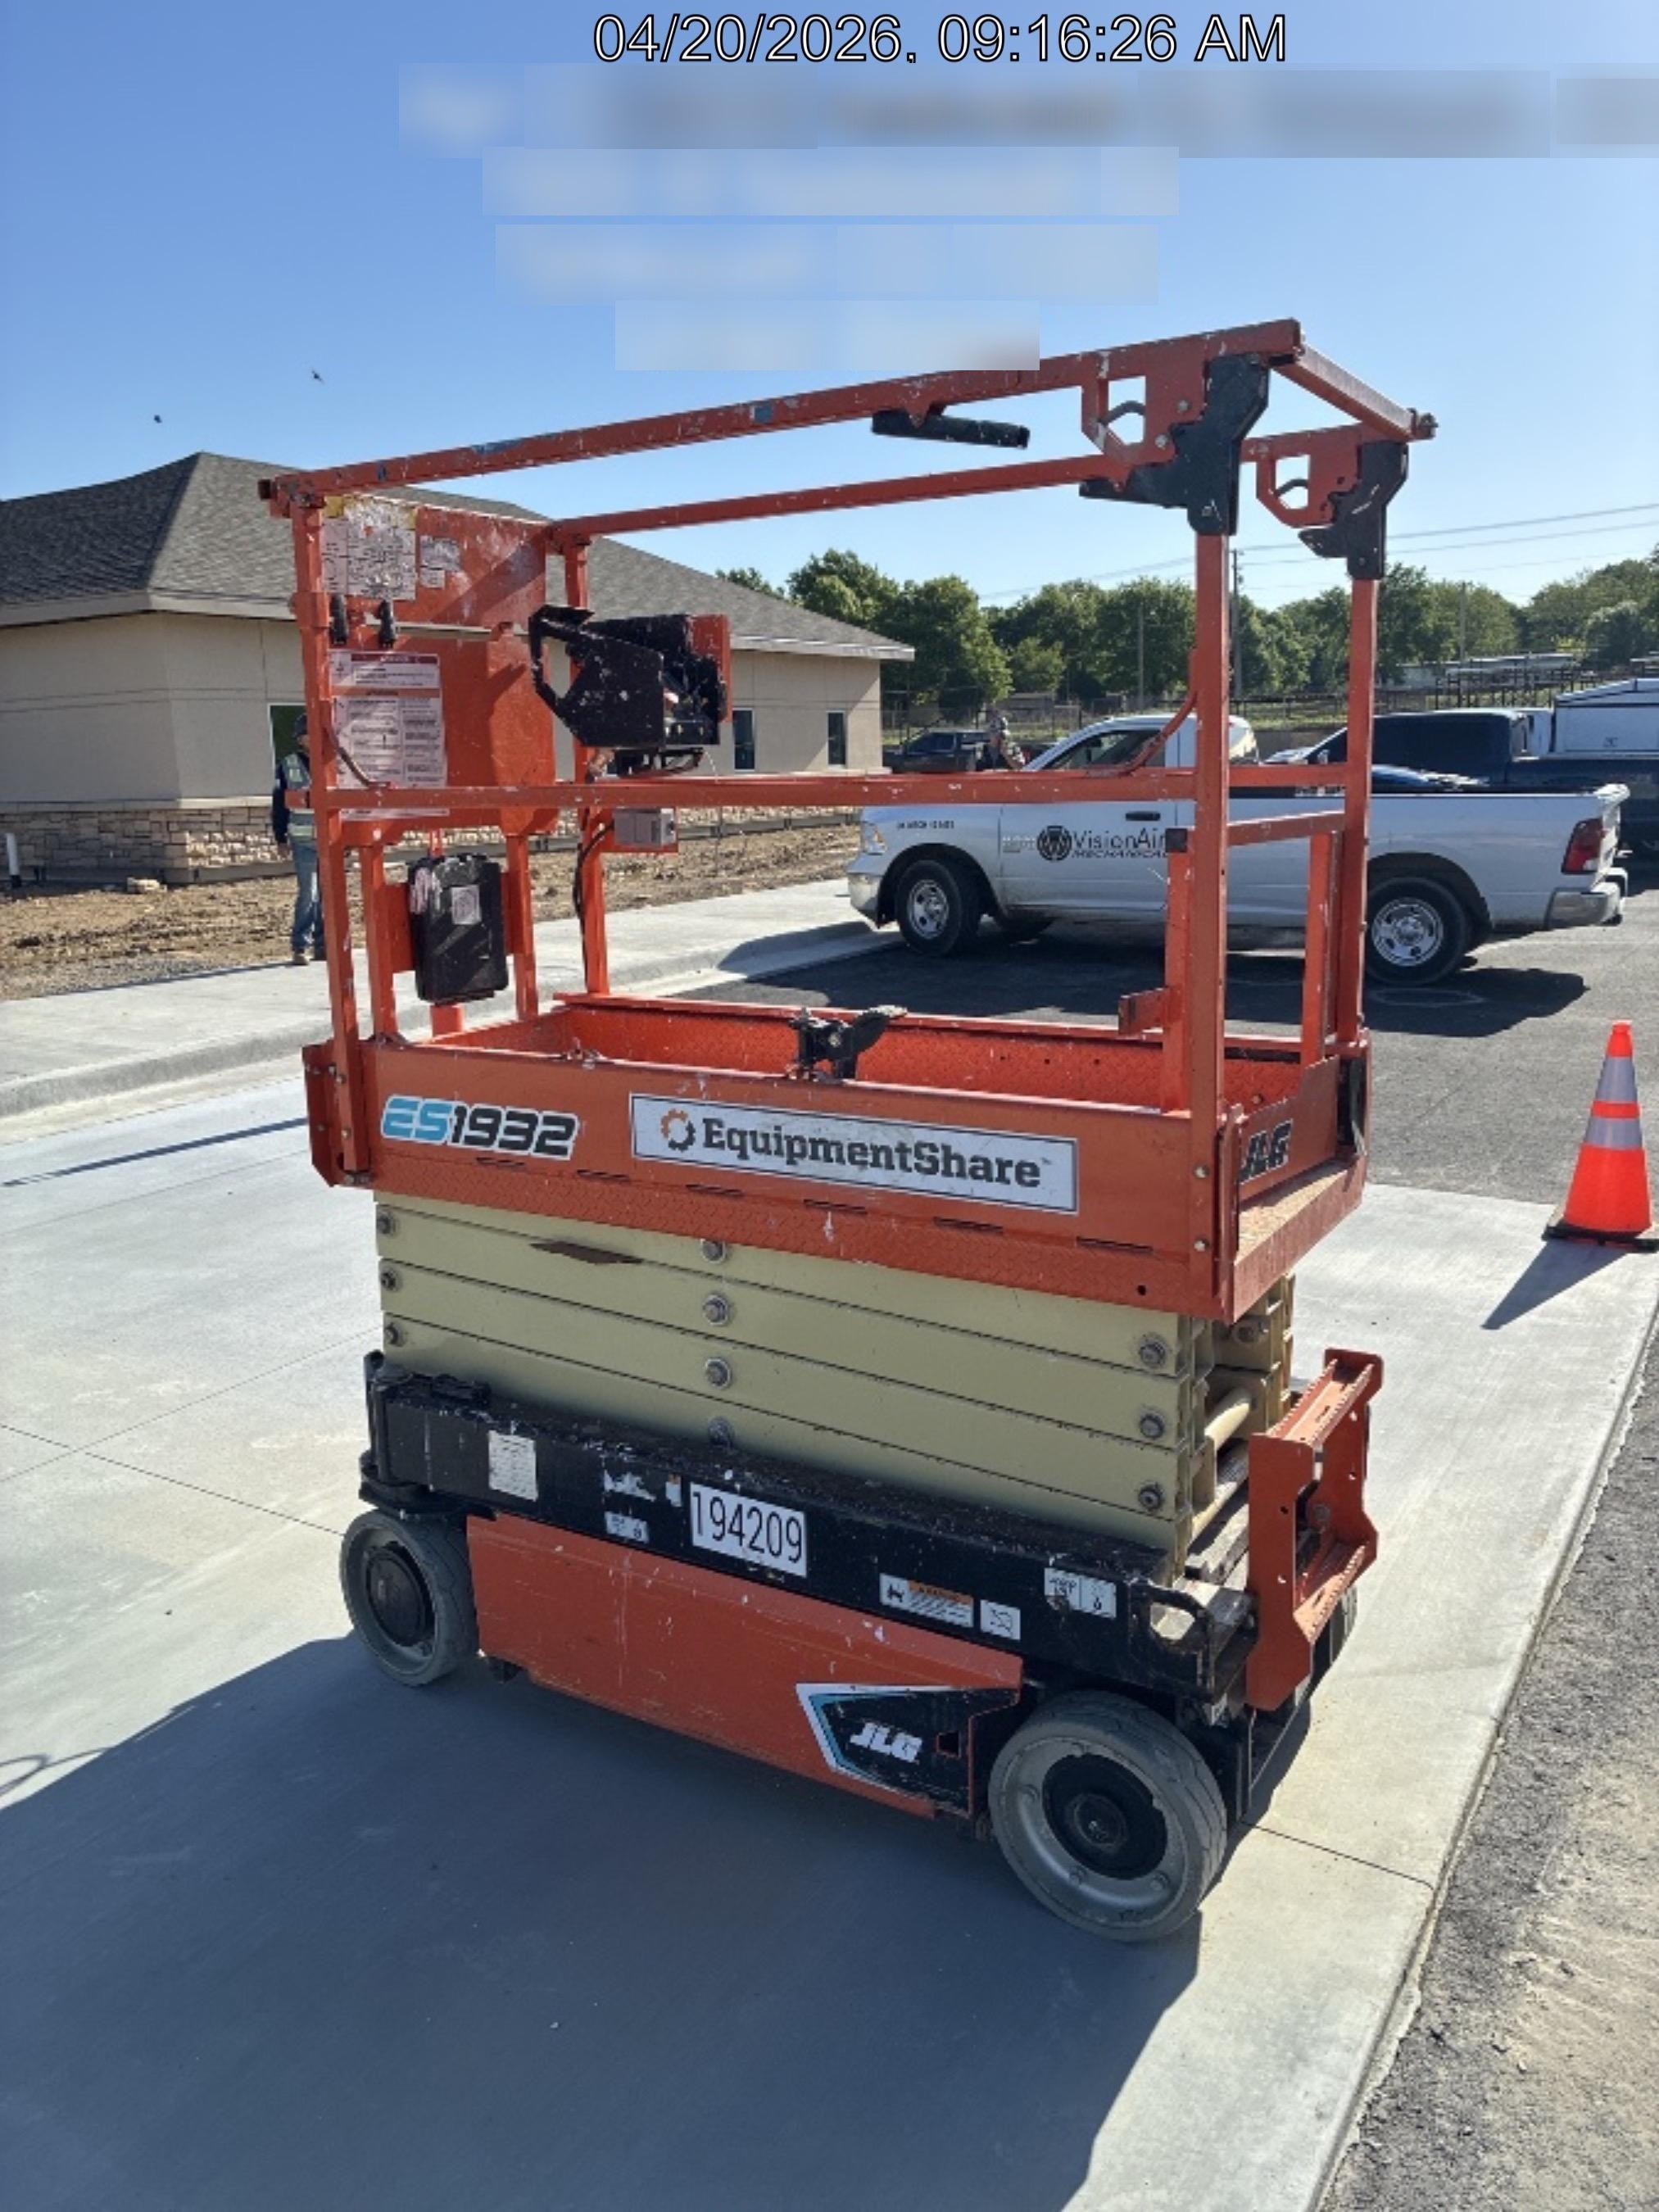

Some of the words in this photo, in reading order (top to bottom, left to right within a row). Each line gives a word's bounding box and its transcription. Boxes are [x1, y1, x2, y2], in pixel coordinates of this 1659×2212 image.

[382, 1095, 578, 1158] ES1932
[702, 1117, 1041, 1188] EquipmentShare
[692, 1491, 802, 1563] 194209
[850, 1722, 922, 1763] JLG
